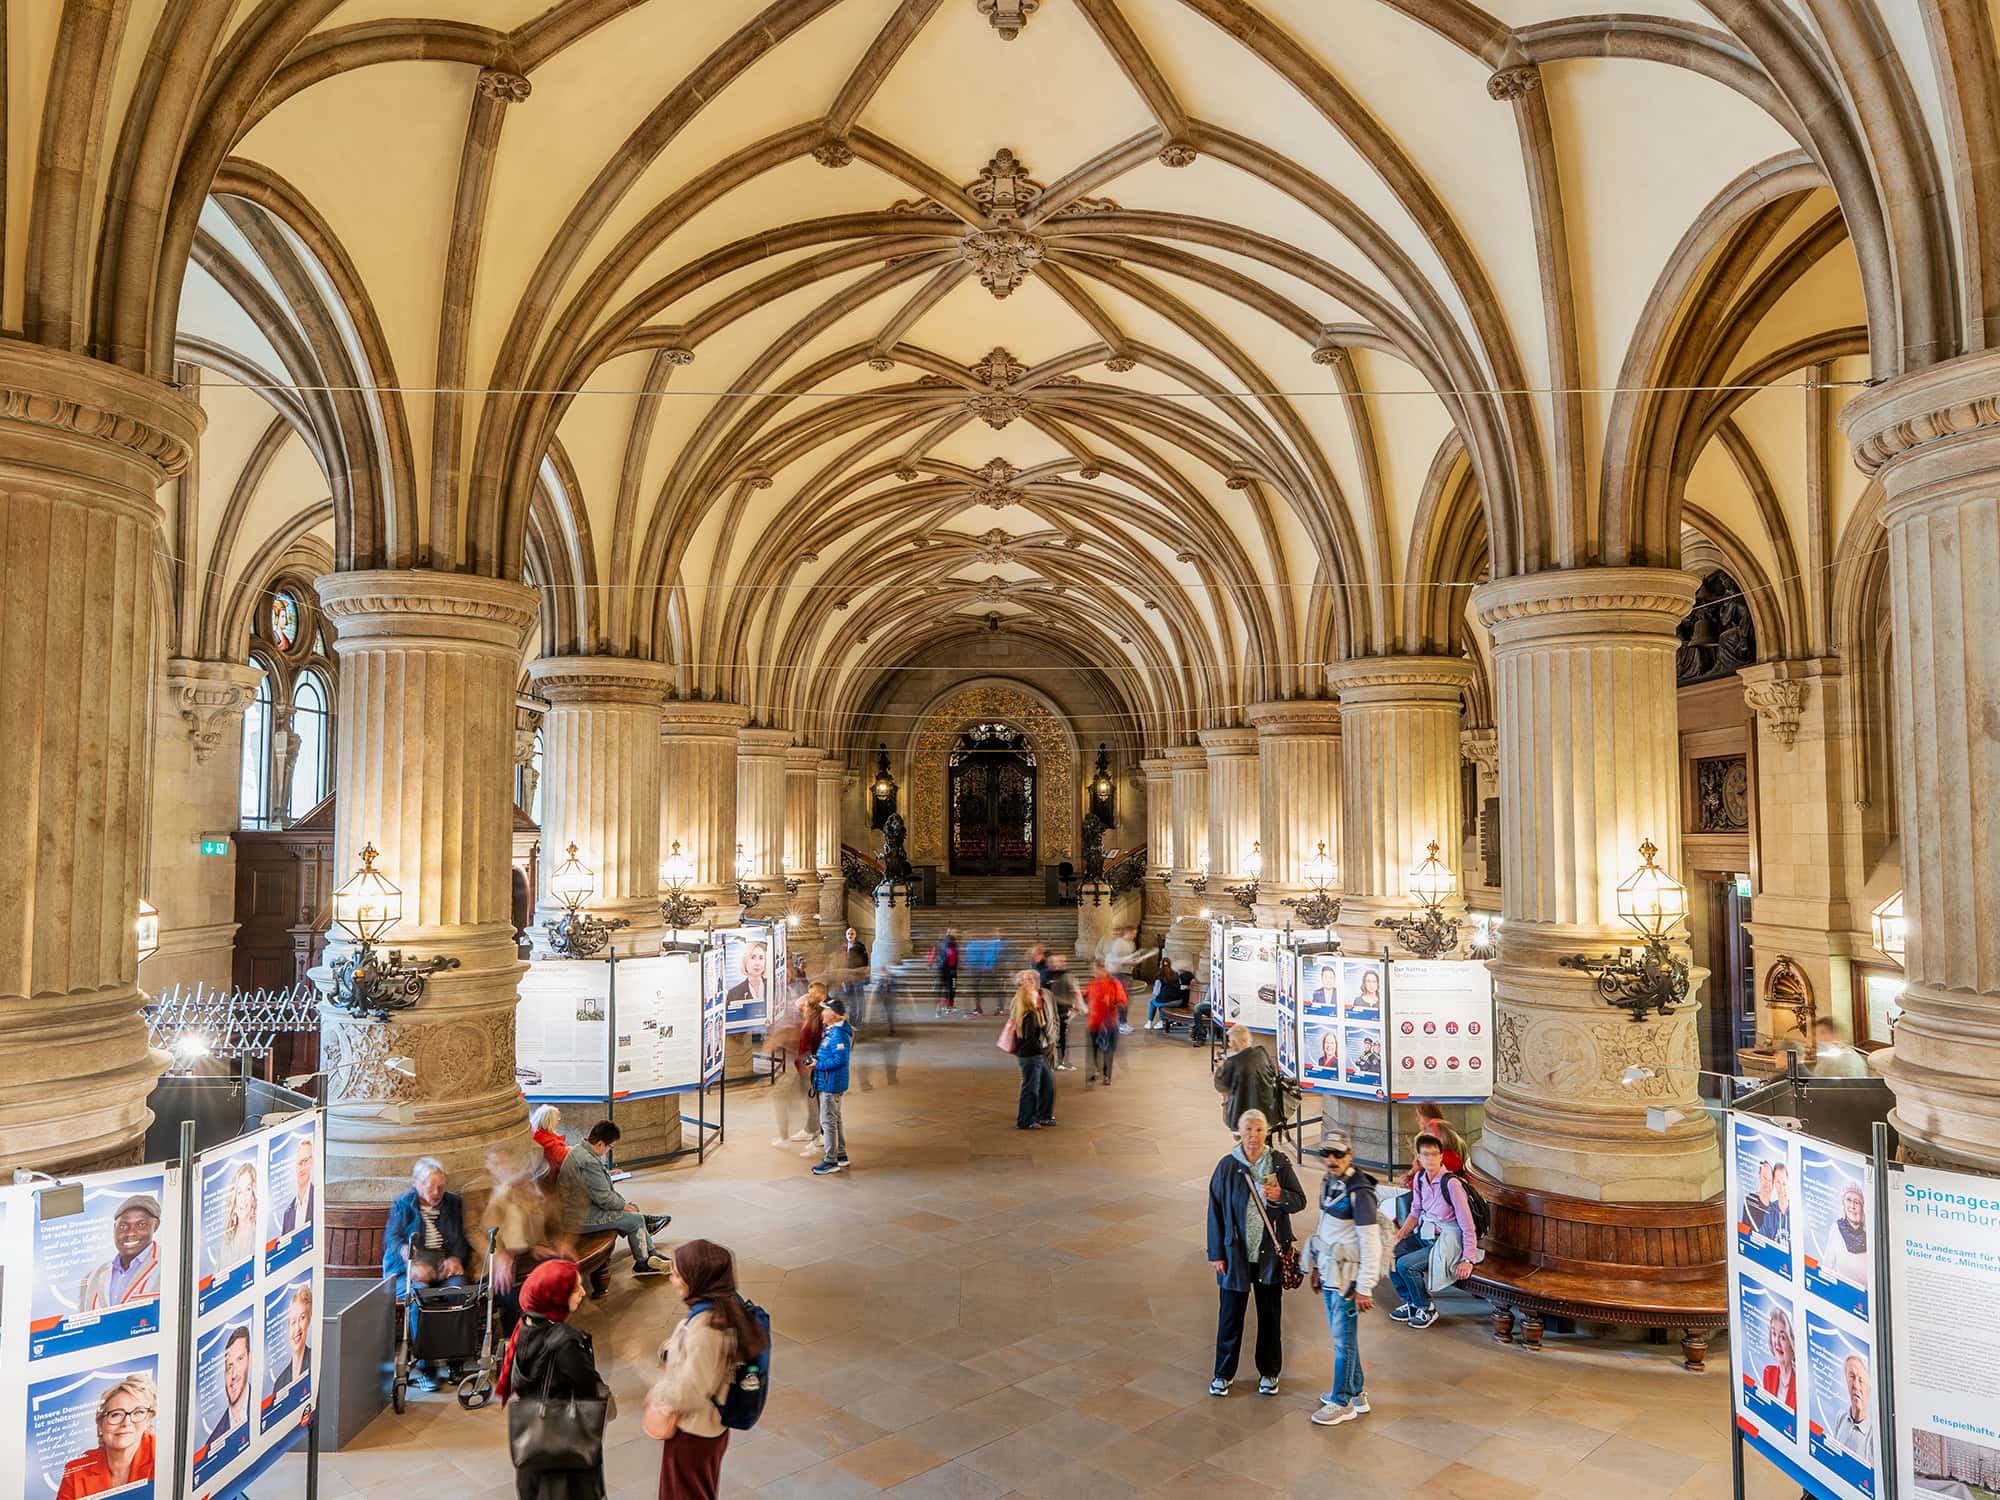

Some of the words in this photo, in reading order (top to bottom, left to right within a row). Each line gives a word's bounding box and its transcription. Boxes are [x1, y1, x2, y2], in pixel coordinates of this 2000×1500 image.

[1905, 1200, 1920, 1214] in
[33, 1410, 60, 1422] Unsere
[1932, 1414, 1995, 1438] Beispielhafte
